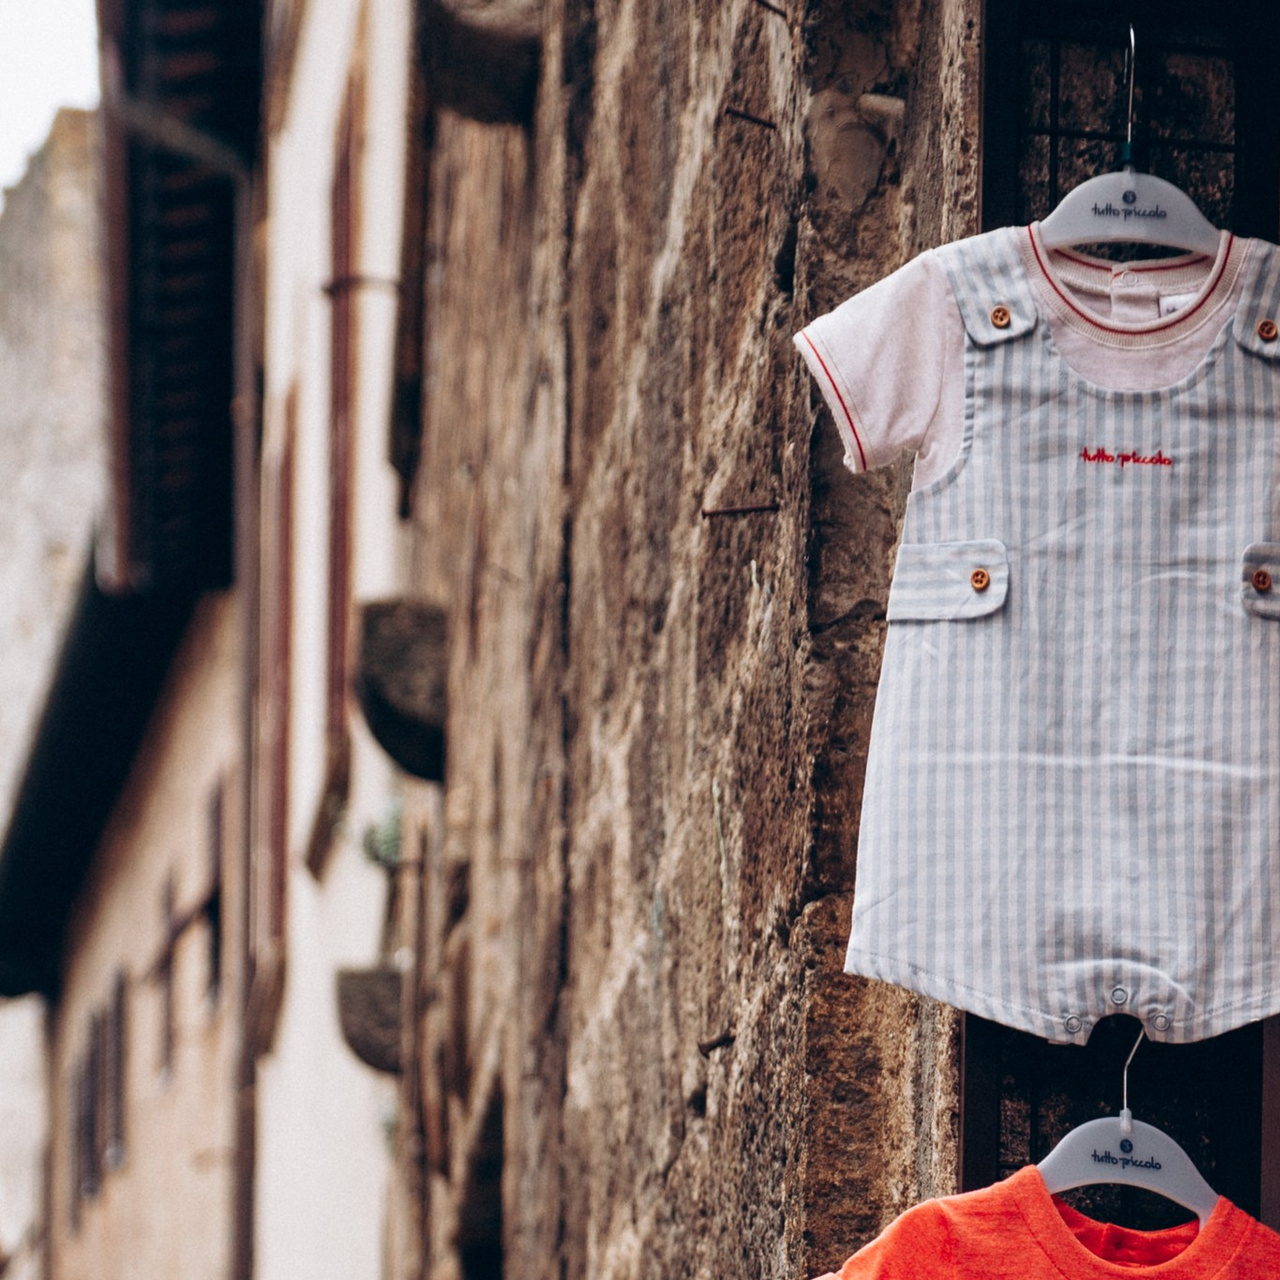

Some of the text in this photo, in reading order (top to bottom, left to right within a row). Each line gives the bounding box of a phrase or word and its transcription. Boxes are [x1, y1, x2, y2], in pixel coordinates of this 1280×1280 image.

[1091, 202, 1167, 221] tutto piccolo
[1091, 1149, 1162, 1171] tutto piccolo
